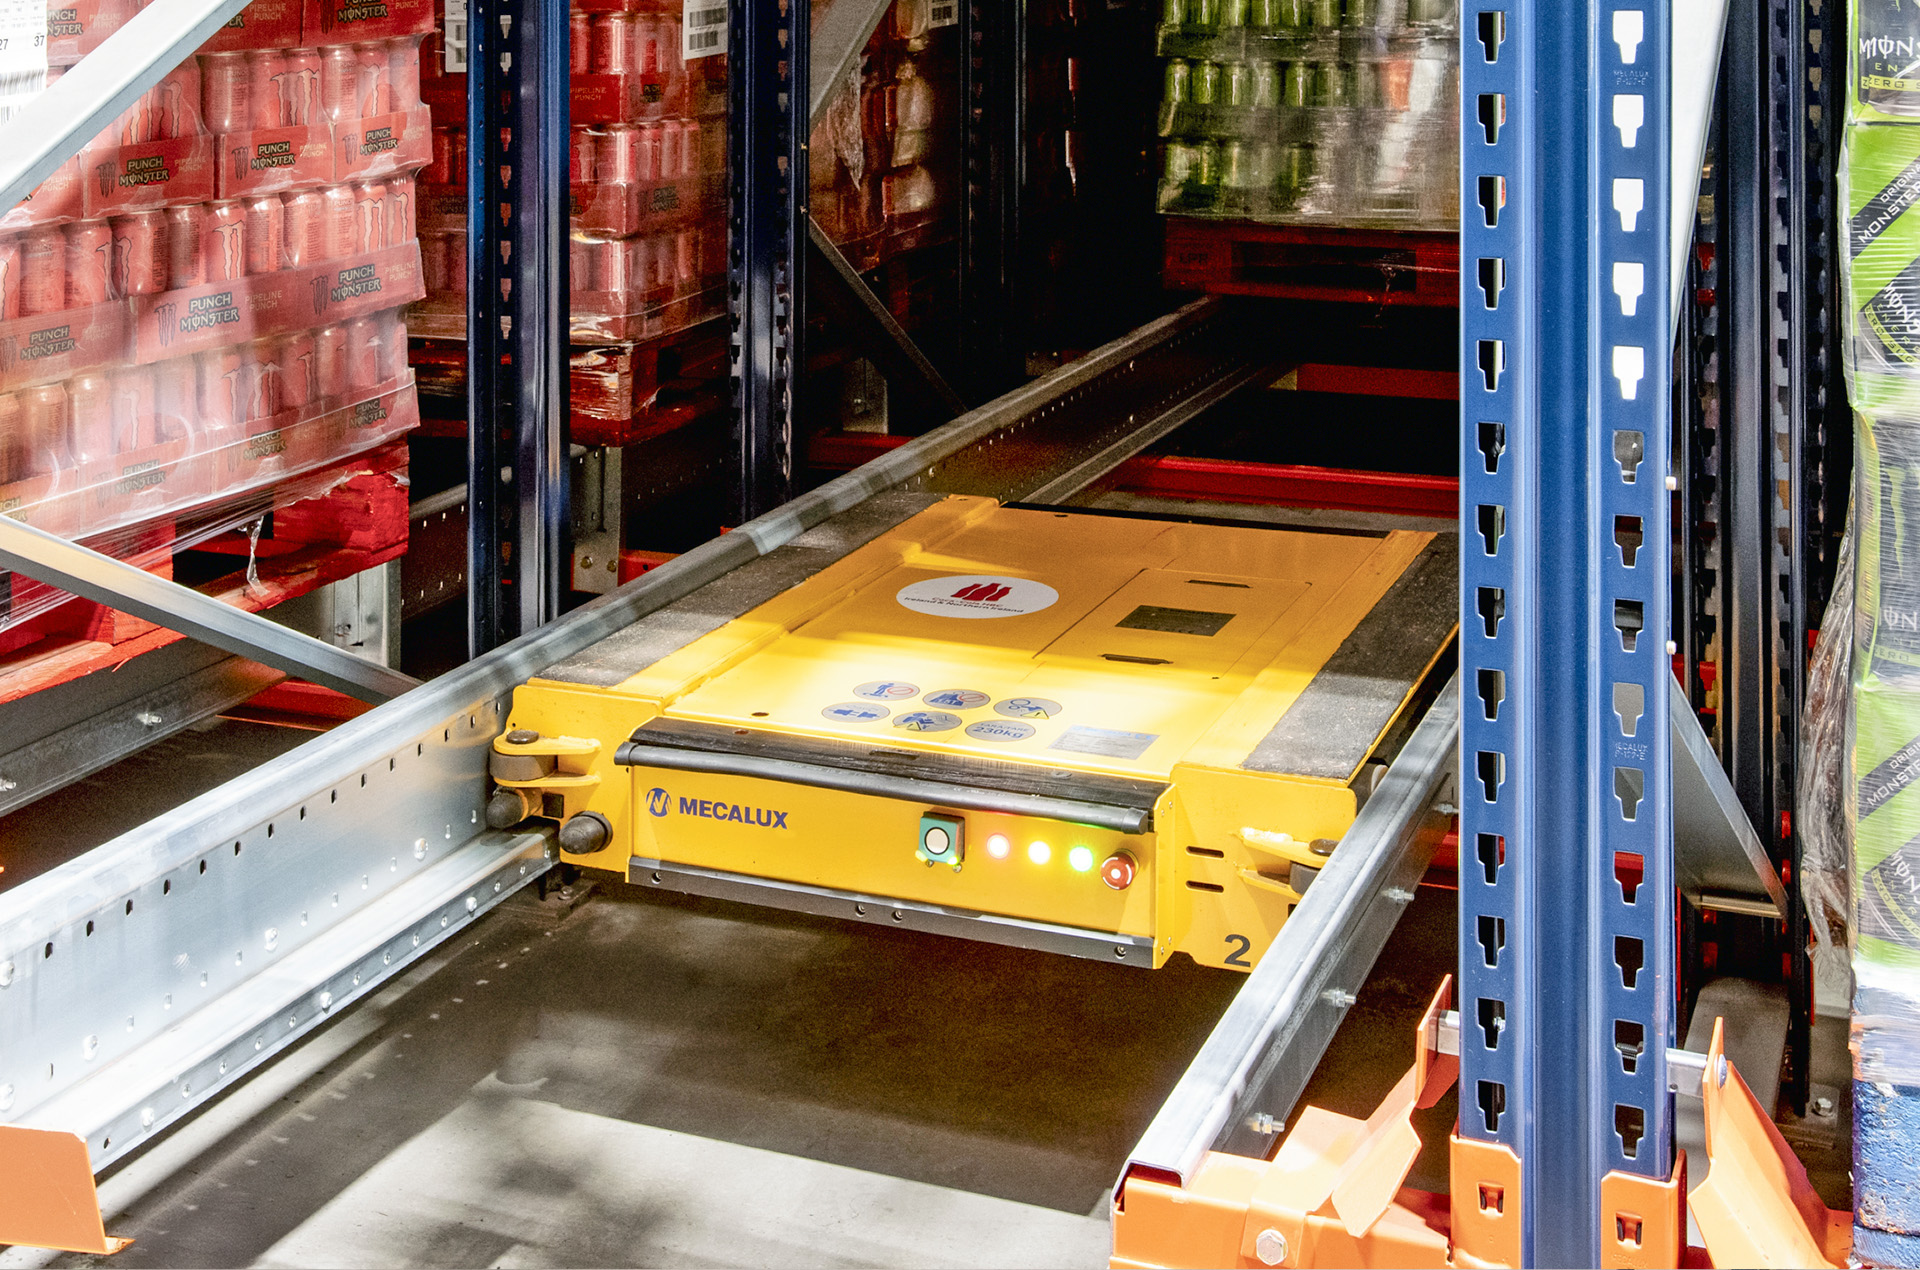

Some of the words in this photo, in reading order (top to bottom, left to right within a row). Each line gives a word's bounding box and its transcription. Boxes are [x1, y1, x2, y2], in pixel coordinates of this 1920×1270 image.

[47, 9, 77, 21] UNCH
[254, 12, 281, 21] PUNCH
[338, 4, 388, 23] MONSTER
[47, 22, 83, 37] NSTER
[34, 35, 45, 47] 37
[366, 127, 392, 142] PUNCH
[258, 141, 290, 156] PUNCH
[360, 139, 399, 155] MONSTER
[127, 156, 164, 171] PUNCH
[251, 154, 296, 171] MONSTER
[119, 169, 170, 187] MONSTER
[339, 264, 375, 284] PUNCH
[385, 261, 415, 274] PIPELINE
[389, 271, 412, 281] PUNCH
[245, 290, 282, 303] PIPELINE
[331, 278, 382, 302] MONSTER
[189, 292, 232, 313] PUNCH
[249, 301, 278, 312] PUNCH
[180, 307, 240, 332] MONSTER
[29, 325, 70, 344] PUNCH
[20, 339, 76, 361] MONSTER
[946, 601, 990, 610] Northern
[972, 726, 1024, 738] 230kg
[679, 796, 789, 830] MECALUX
[1224, 934, 1251, 967] 2
